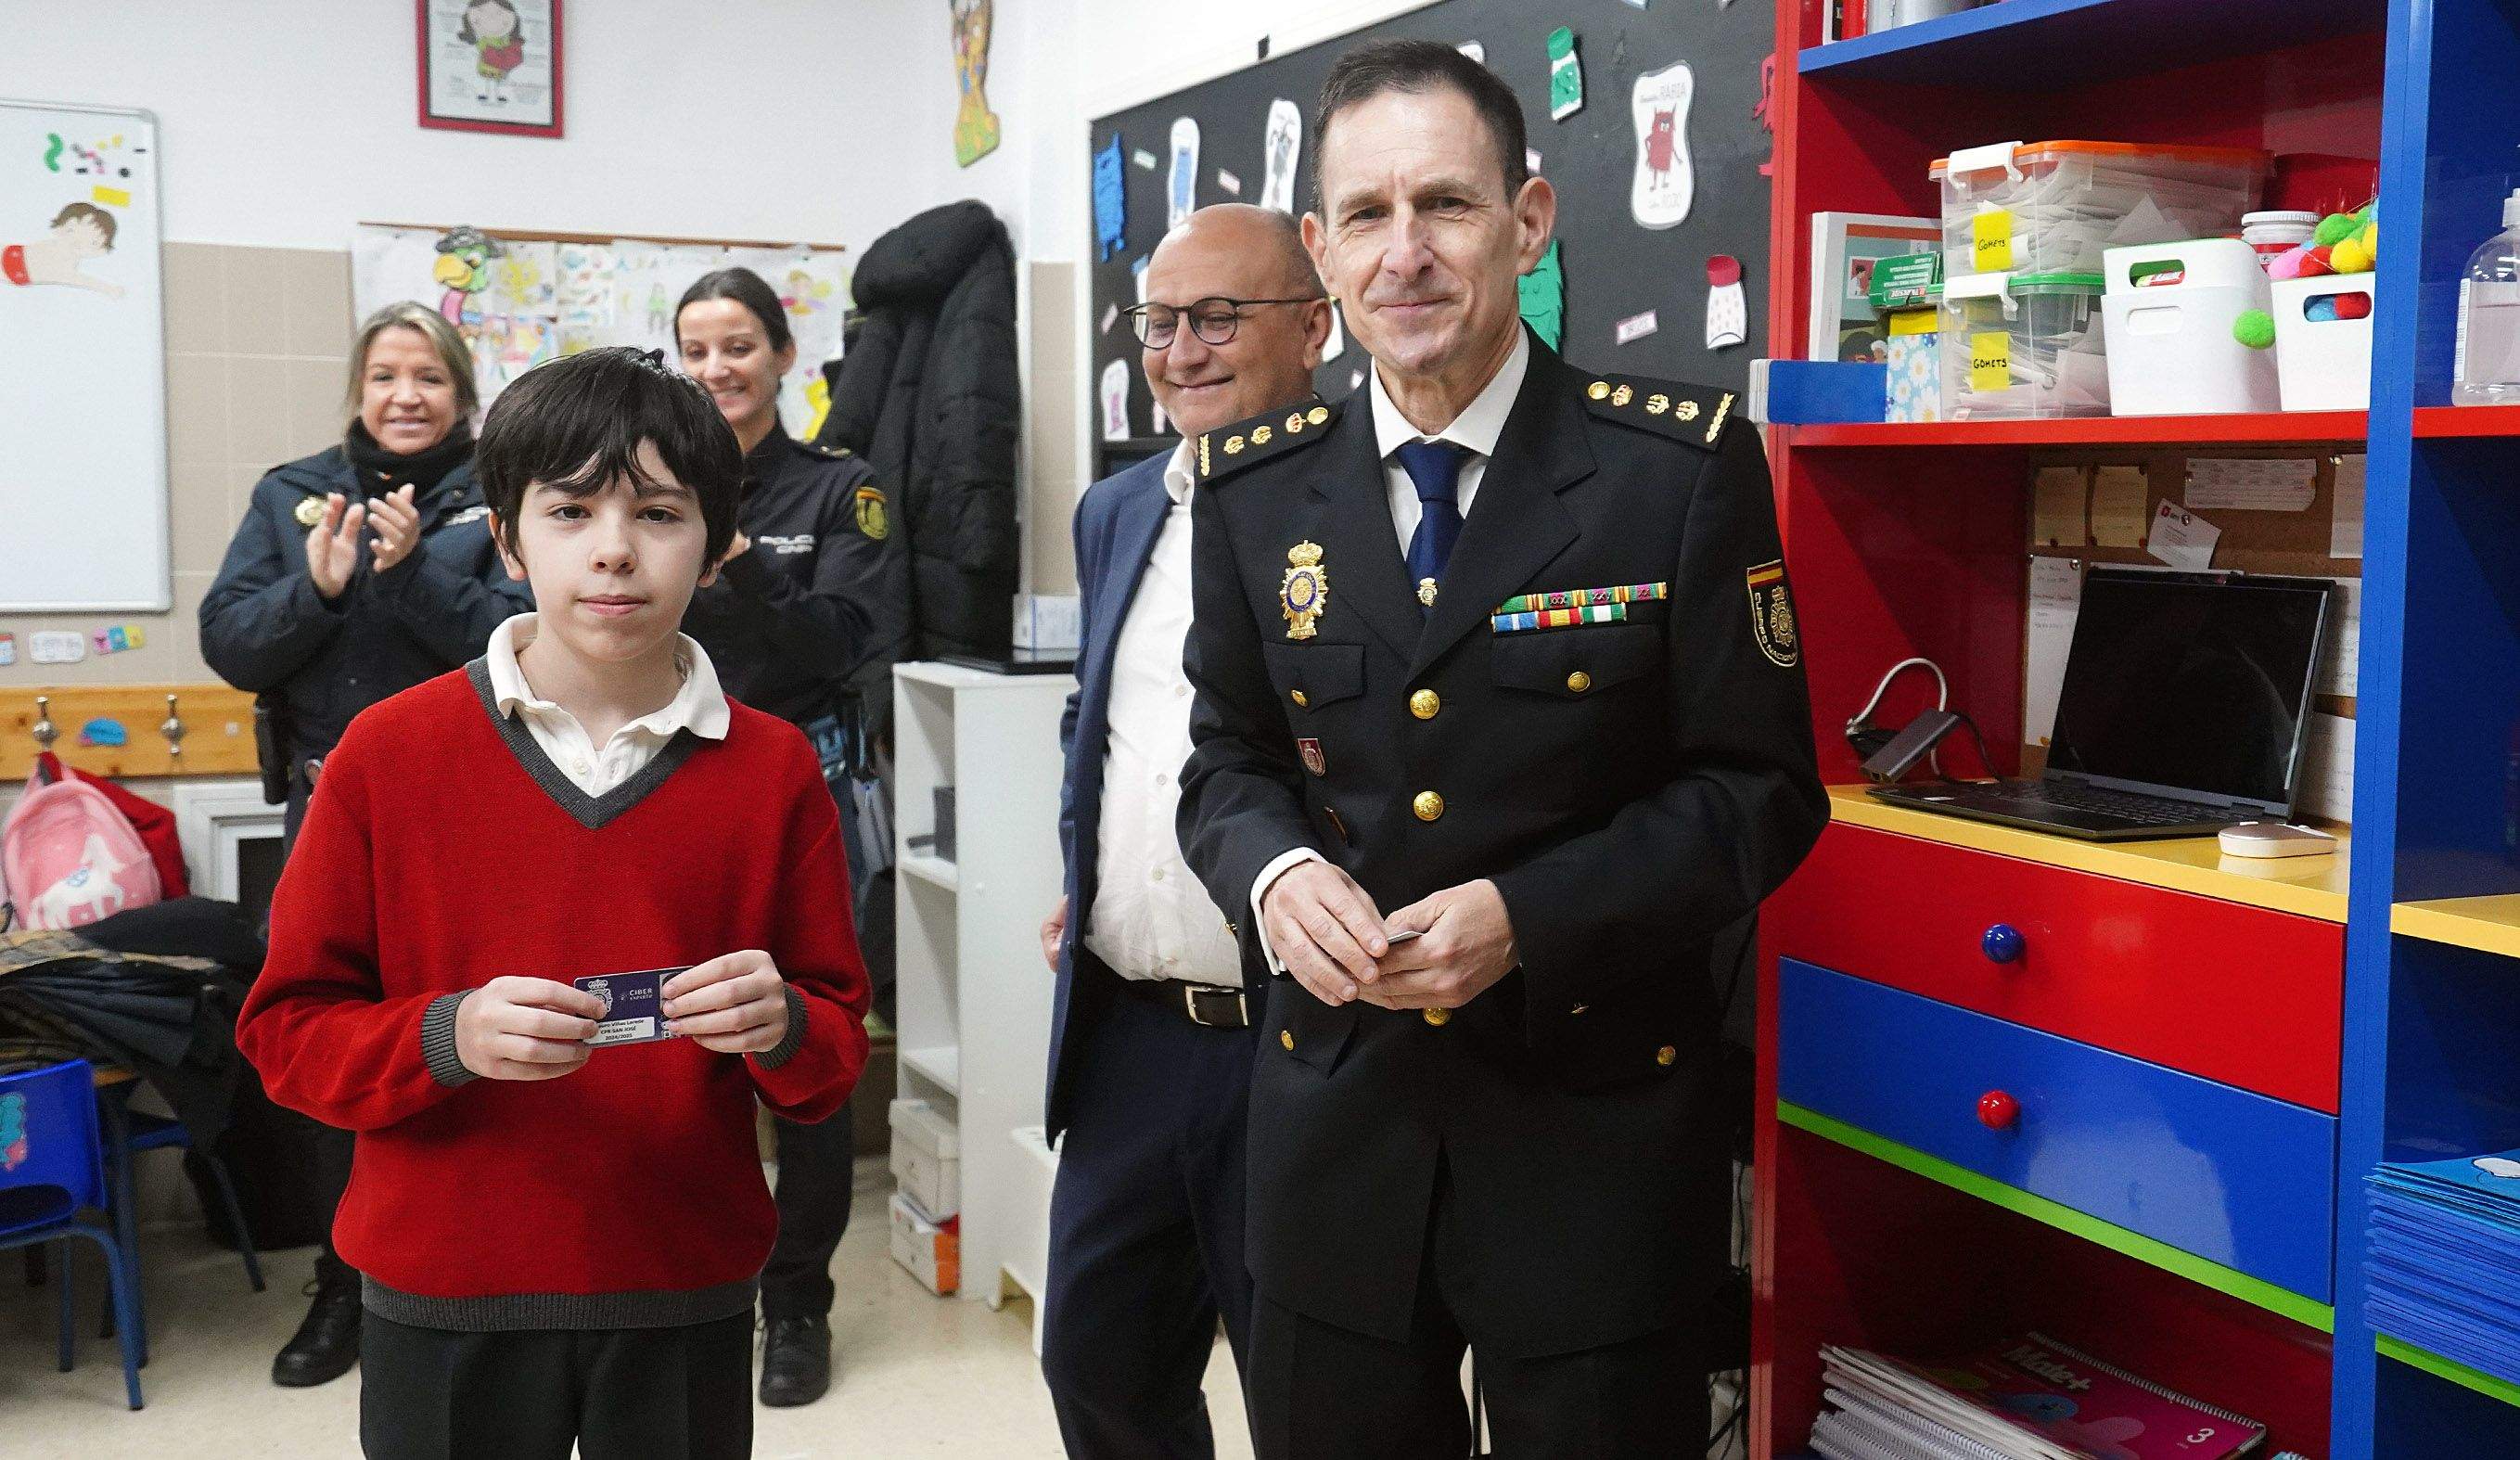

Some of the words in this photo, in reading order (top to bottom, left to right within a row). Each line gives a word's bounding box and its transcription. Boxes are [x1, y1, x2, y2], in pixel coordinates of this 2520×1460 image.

[1973, 357, 2007, 369] GOMETS
[630, 988, 653, 996] CIBER
[2187, 1428, 2215, 1443] 3
